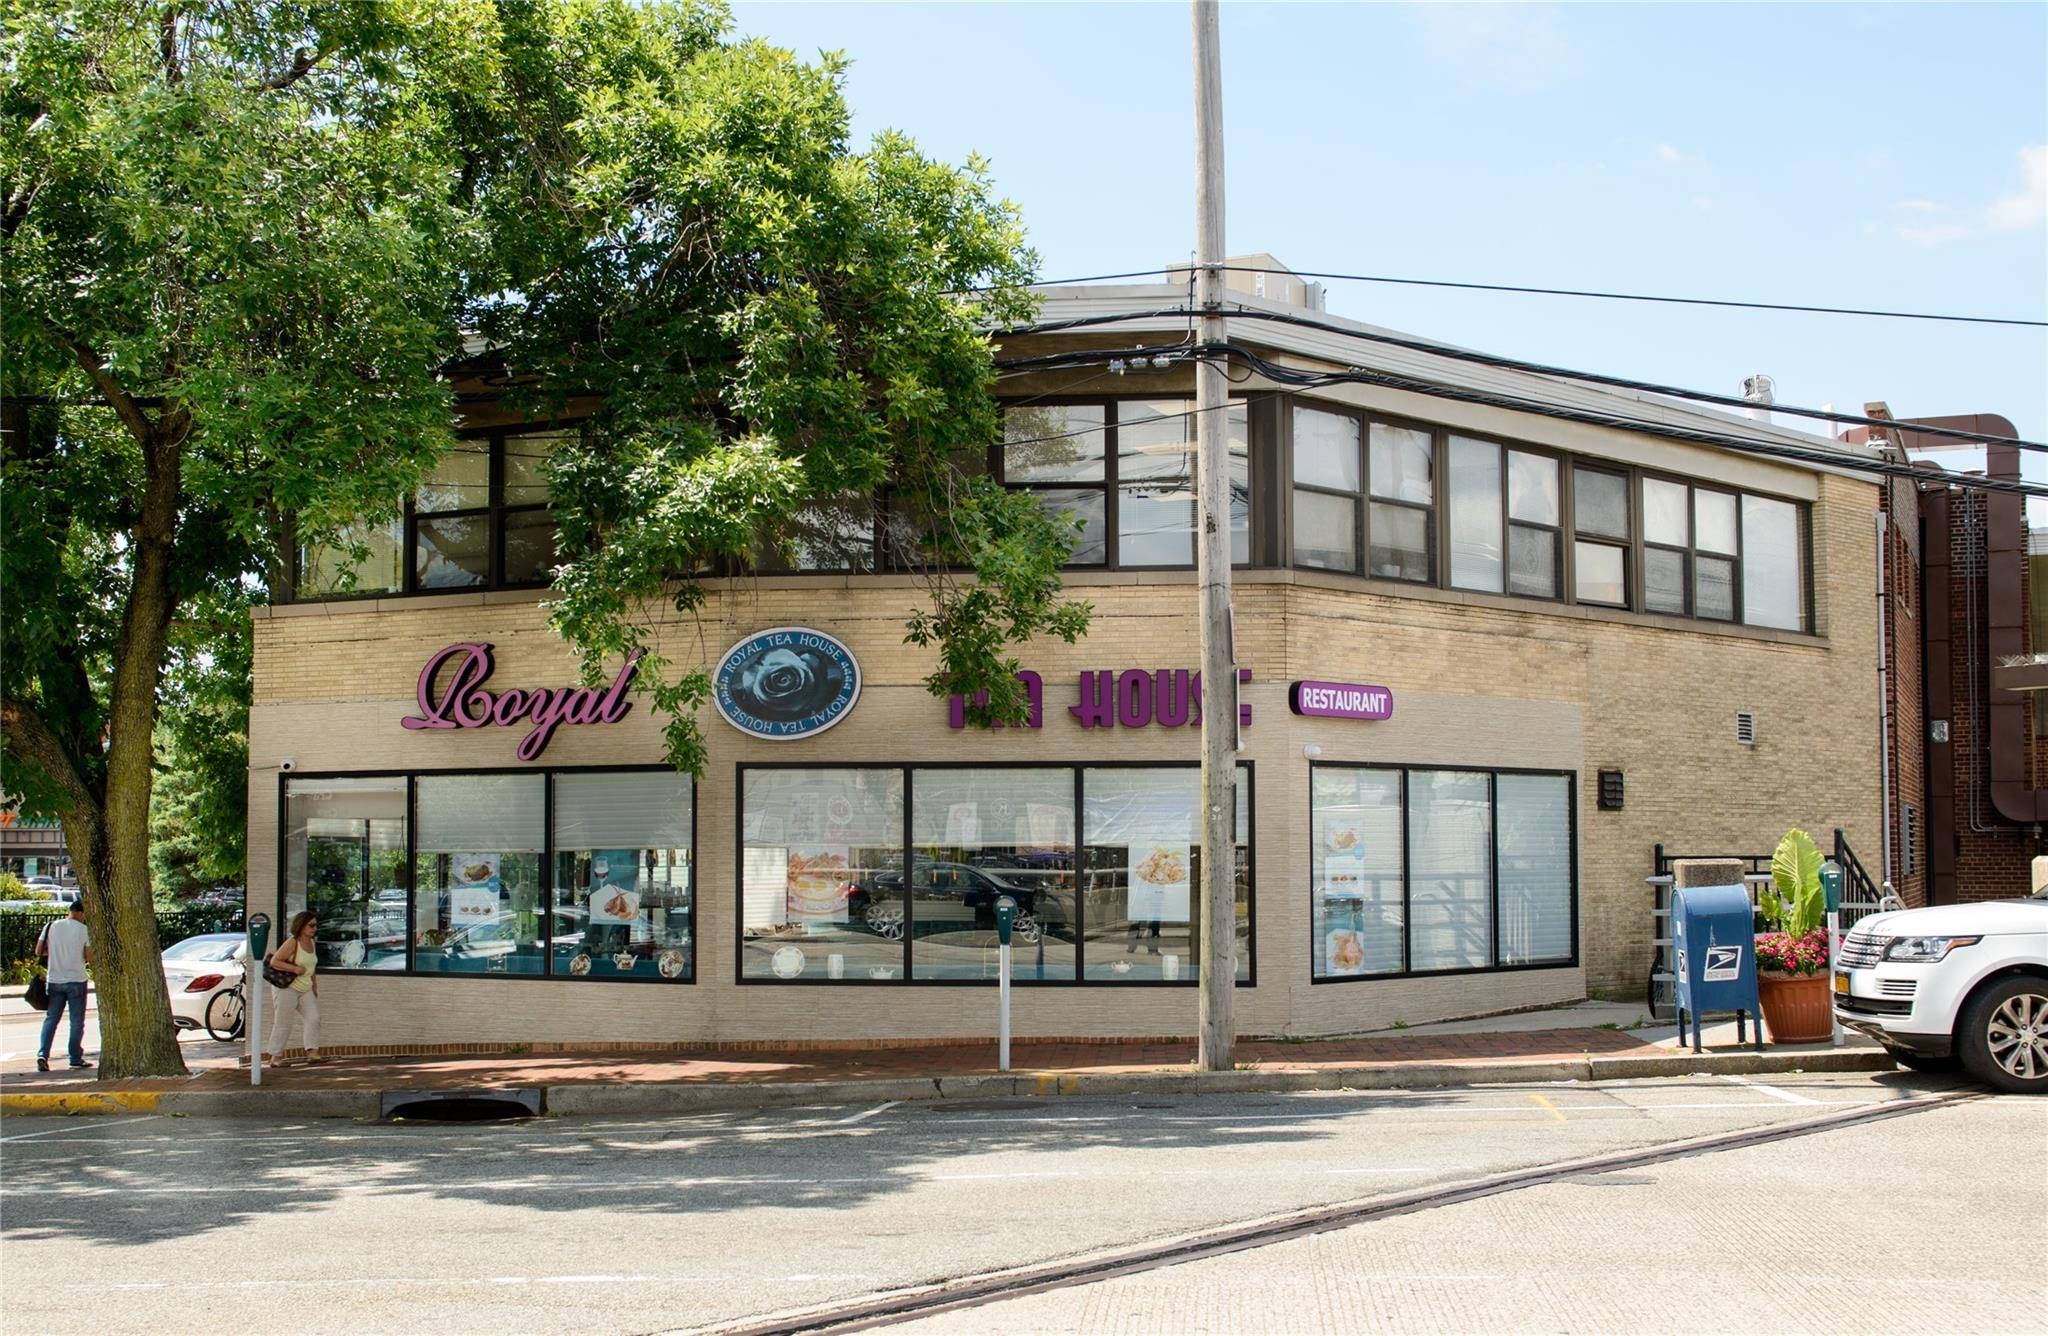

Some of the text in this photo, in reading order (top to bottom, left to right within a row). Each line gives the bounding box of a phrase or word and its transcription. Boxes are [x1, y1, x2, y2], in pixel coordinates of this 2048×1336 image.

[725, 634, 843, 673] ROYAL TEA HOUSE
[400, 642, 648, 761] Royal
[730, 696, 848, 733] ROYAL TEA HOUSE
[1303, 687, 1387, 714] RESTAURANT
